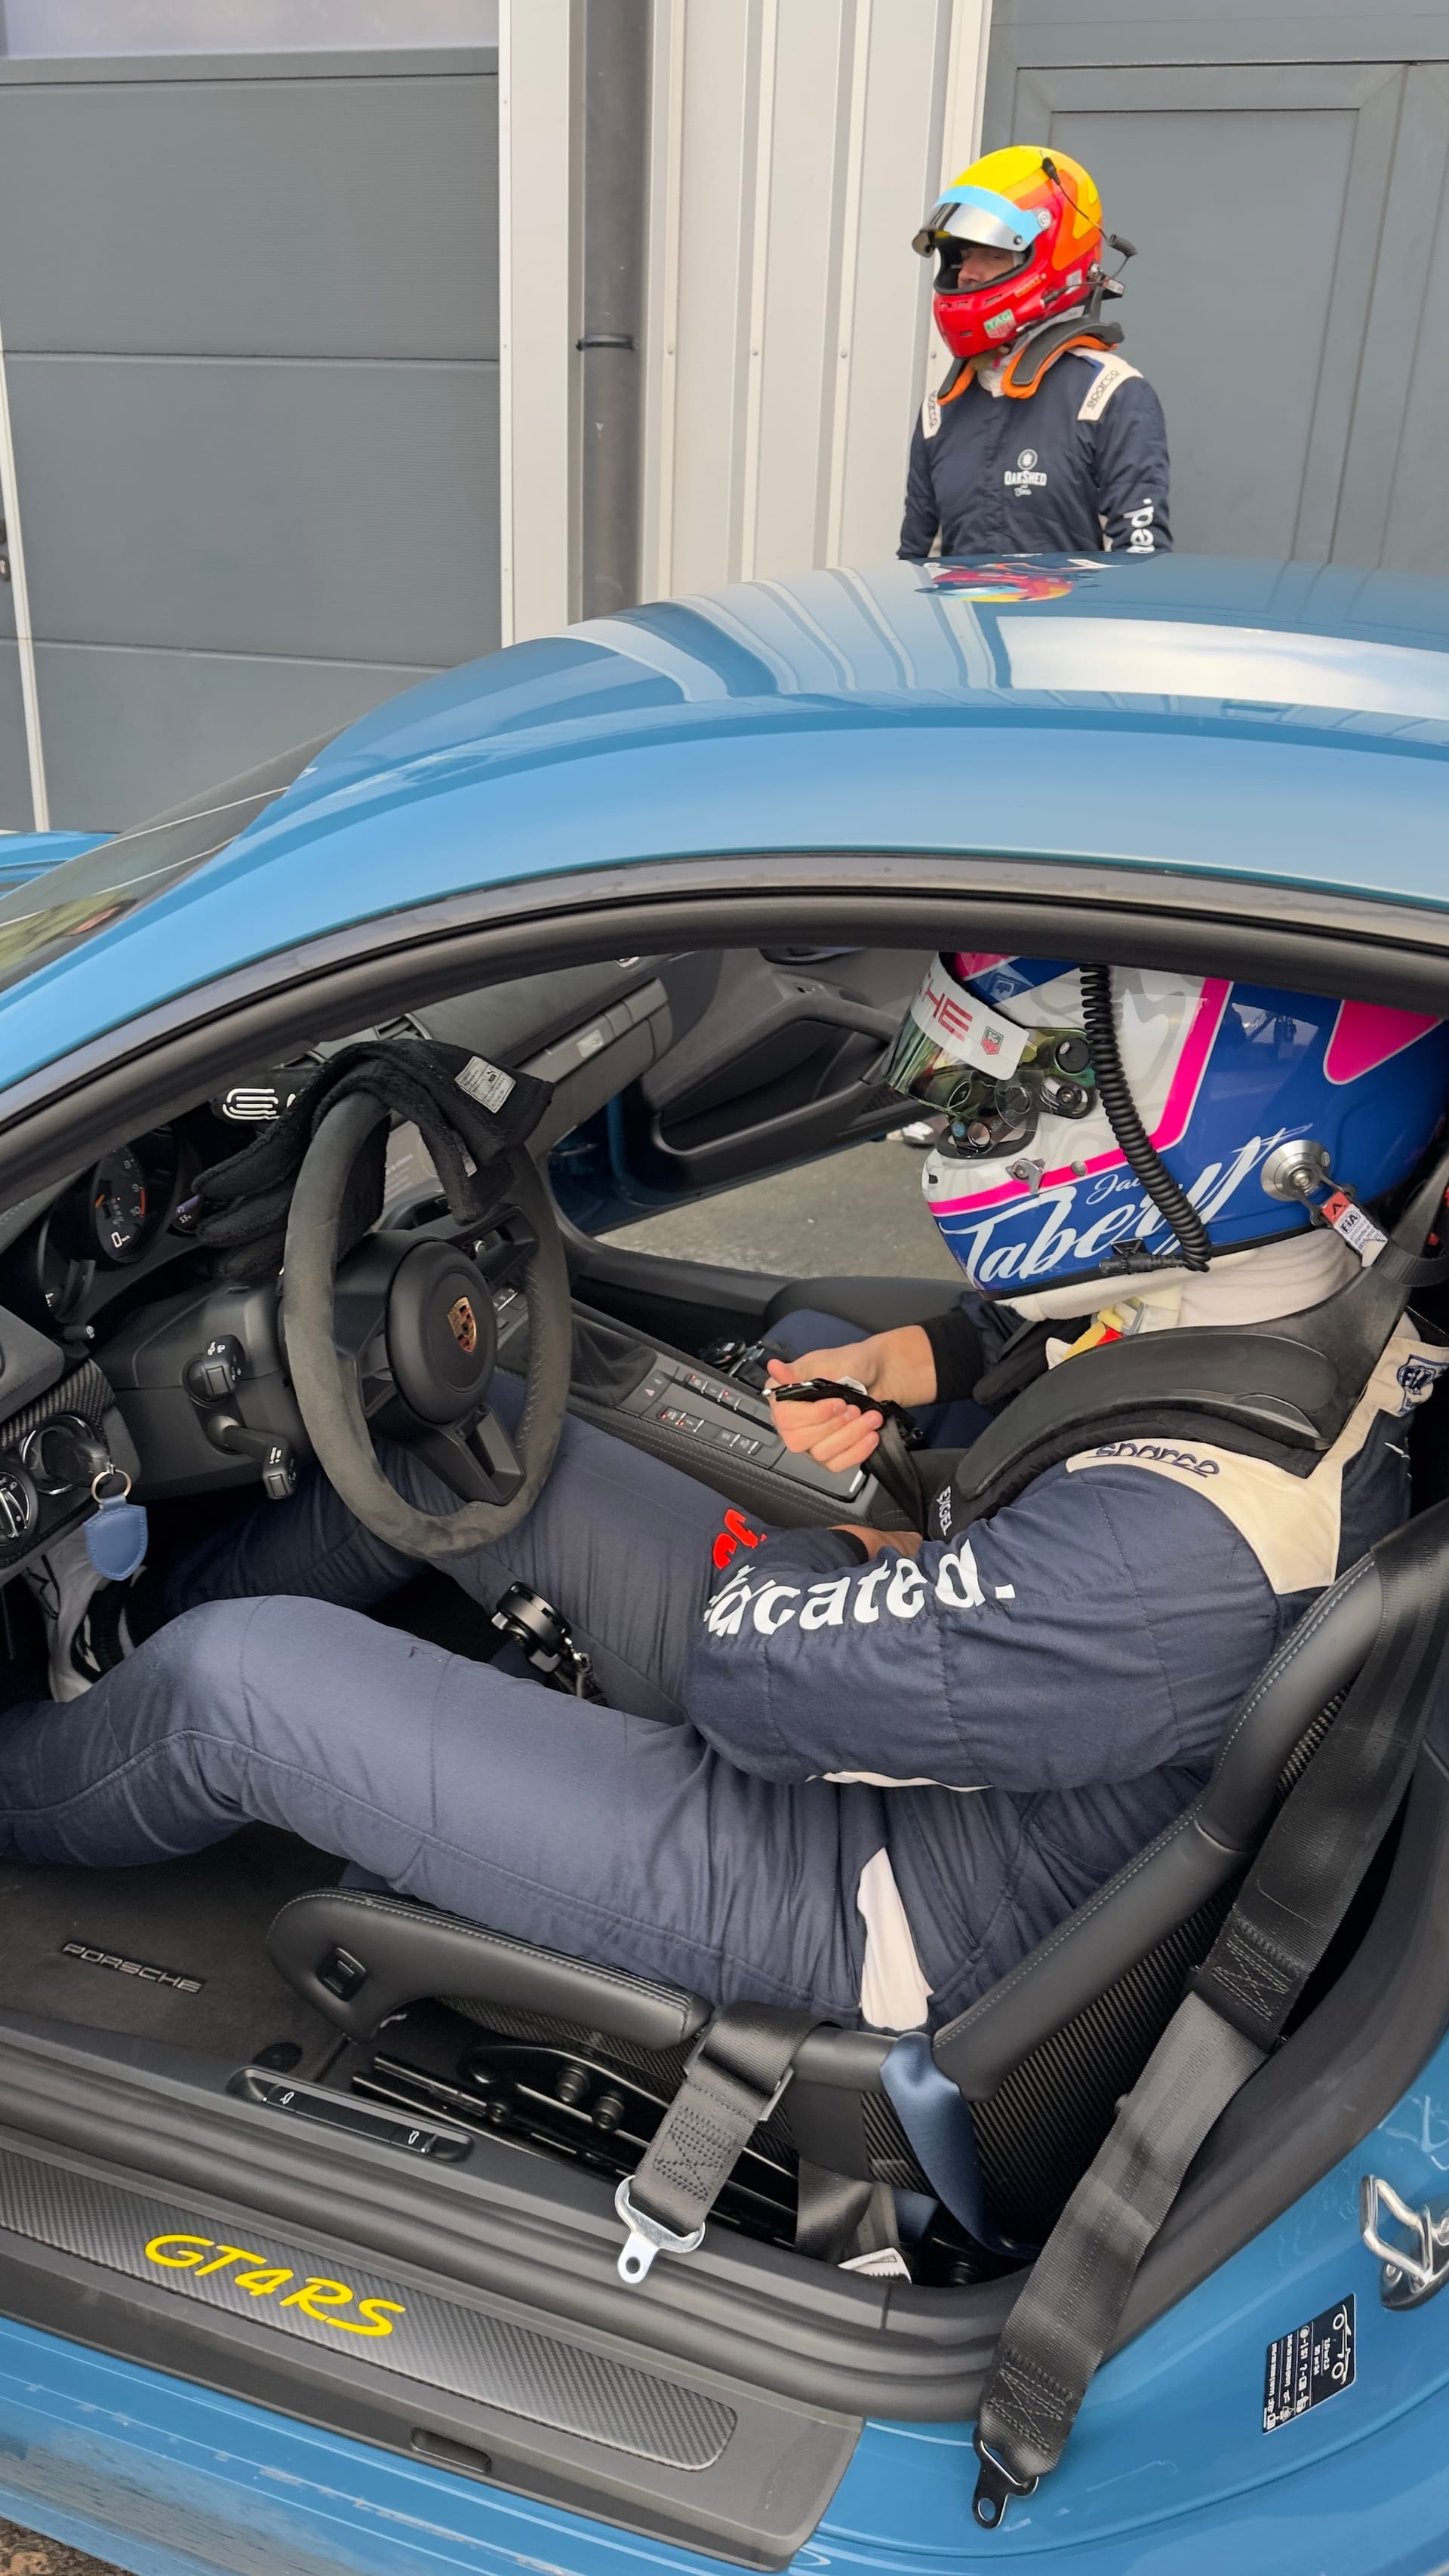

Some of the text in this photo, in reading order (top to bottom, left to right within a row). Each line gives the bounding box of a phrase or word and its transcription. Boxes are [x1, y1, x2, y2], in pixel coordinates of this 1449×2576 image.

[987, 311, 1012, 331] TAG
[1086, 370, 1121, 410] sparco
[1340, 1214, 1358, 1233] FIA
[63, 1942, 202, 1993] PORSCHE
